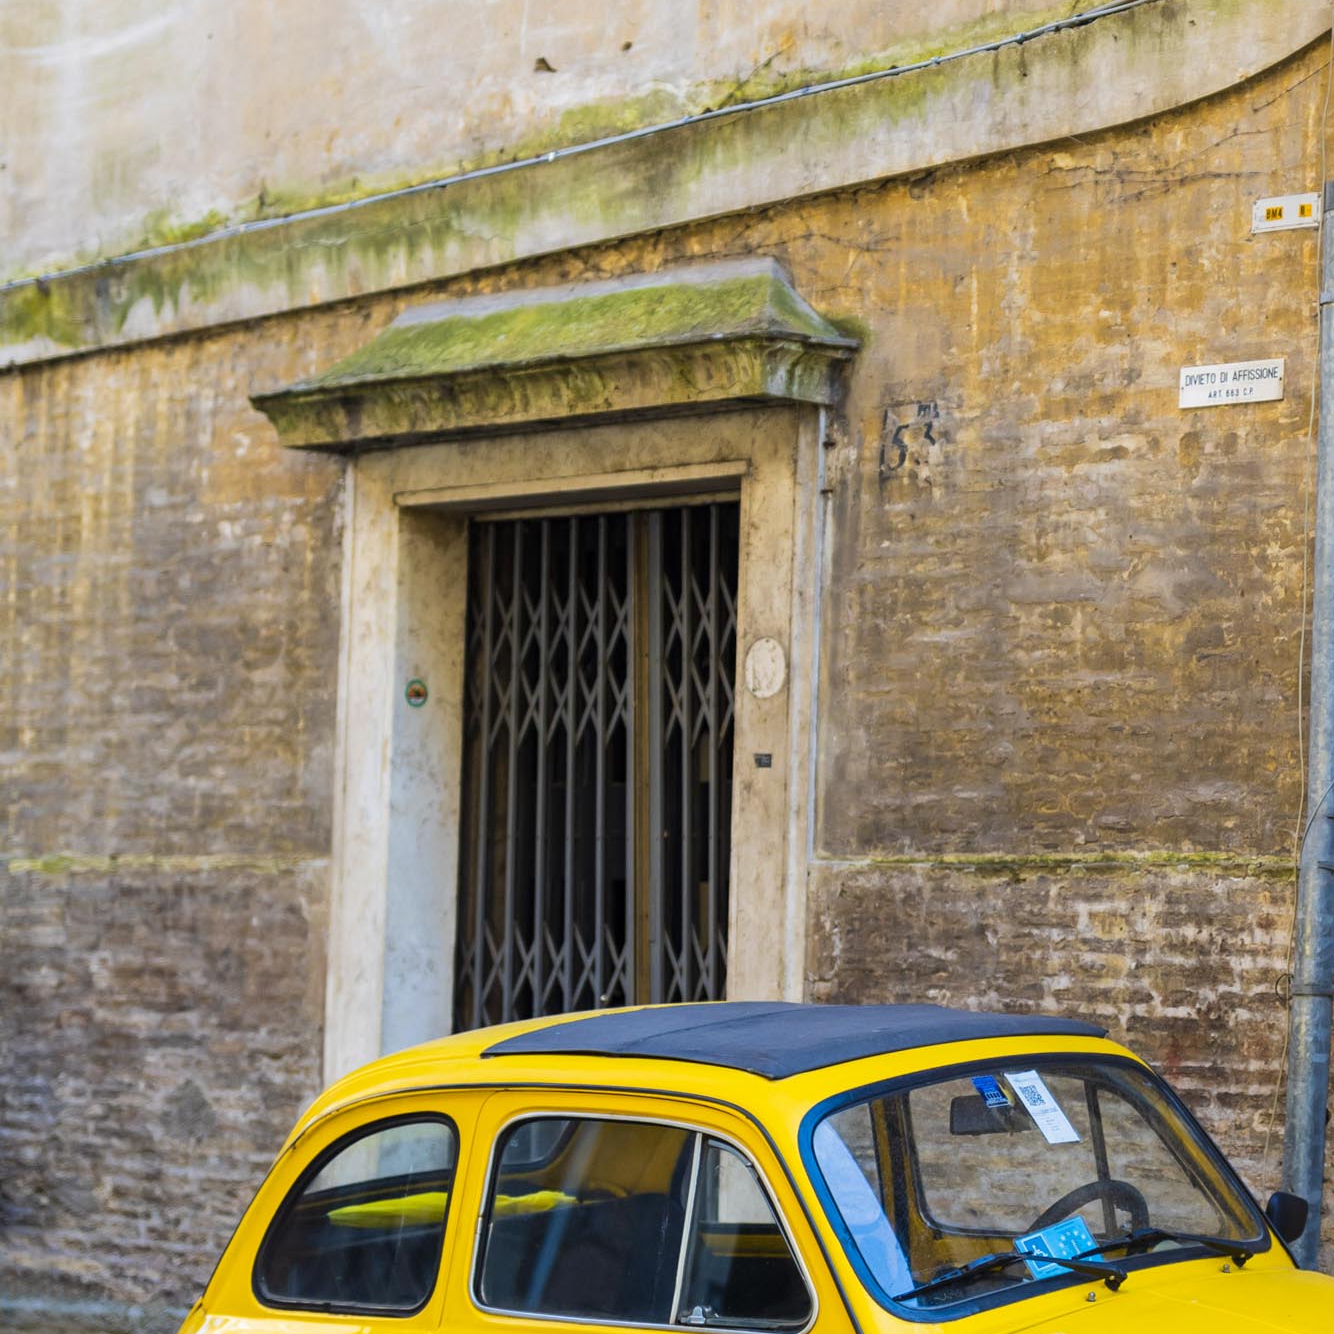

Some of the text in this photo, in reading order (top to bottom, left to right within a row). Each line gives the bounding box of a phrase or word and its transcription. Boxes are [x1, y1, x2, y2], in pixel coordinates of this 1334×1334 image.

[1185, 366, 1279, 387] DIVIETO DI AFFISSIONE
